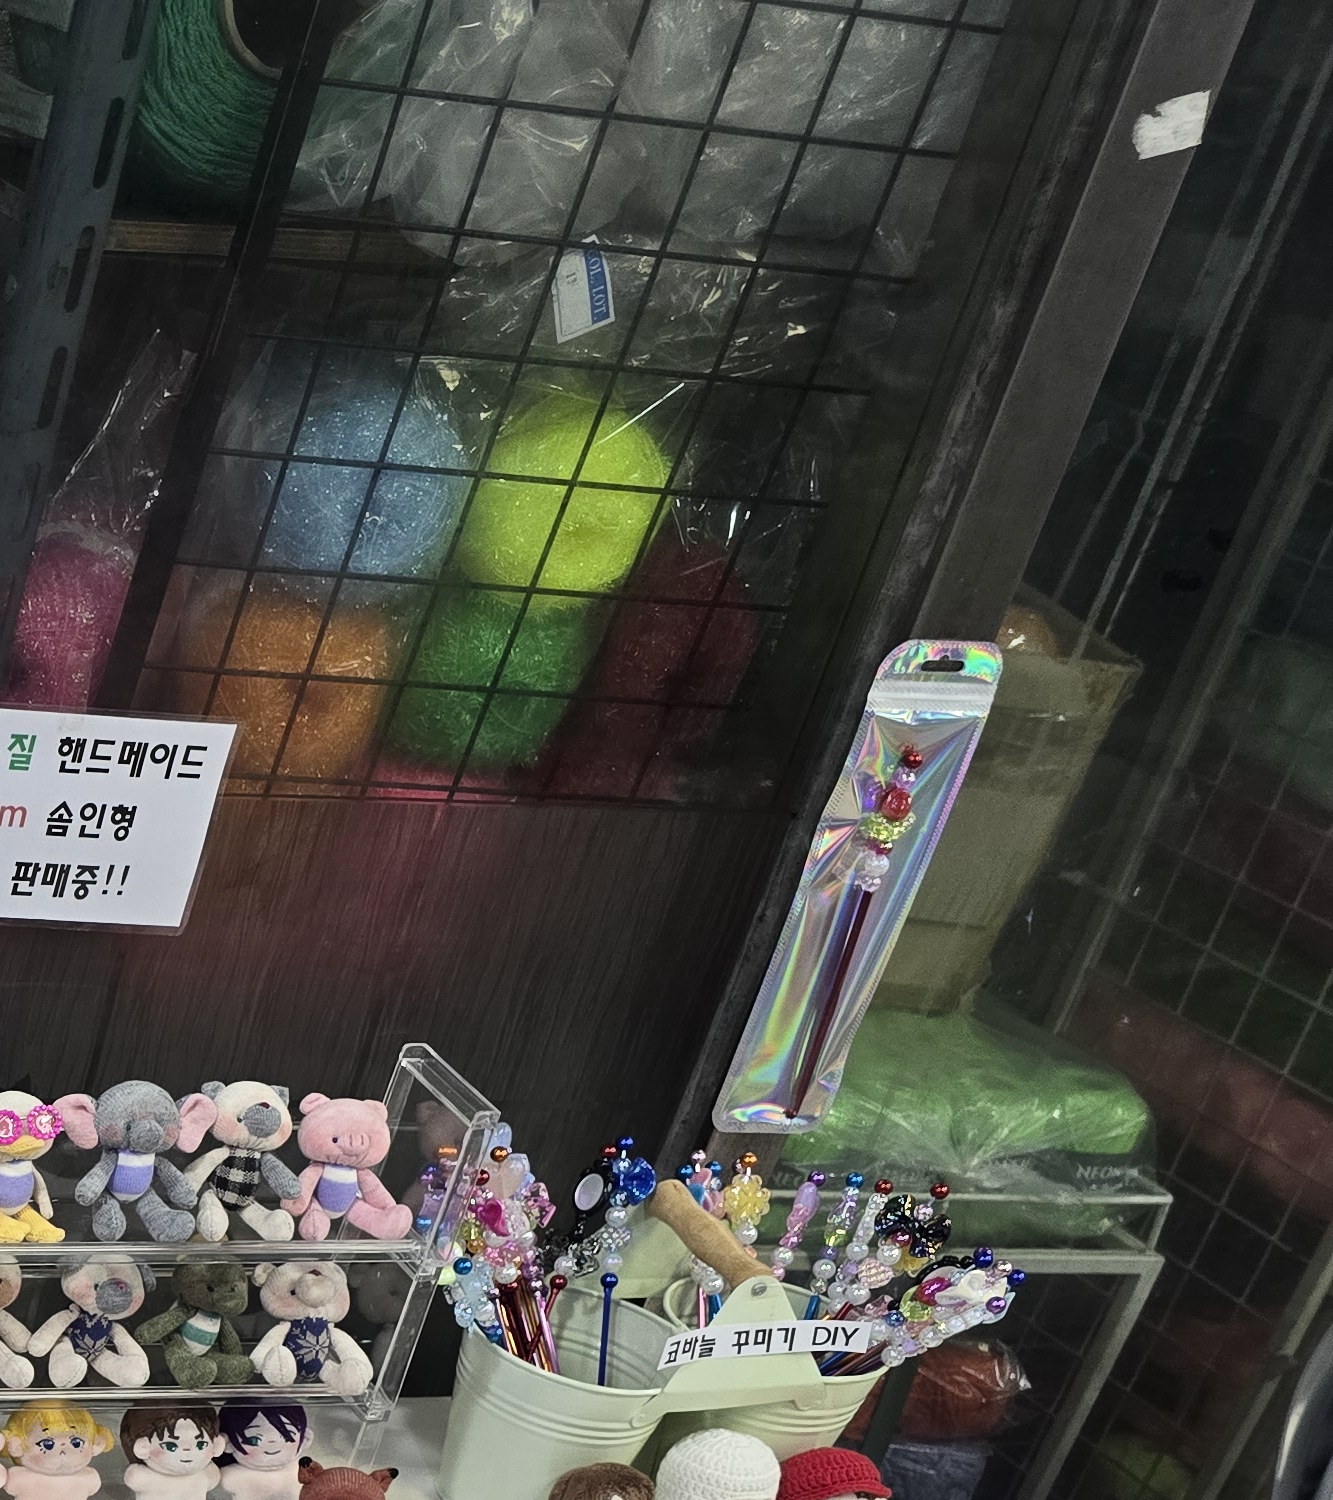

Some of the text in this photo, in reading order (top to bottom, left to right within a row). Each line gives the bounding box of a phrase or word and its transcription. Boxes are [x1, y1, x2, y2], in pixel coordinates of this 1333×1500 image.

[57, 736, 208, 780] 핸드메이드
[45, 800, 137, 842] 솜인형
[11, 860, 131, 901] 판매중!!
[731, 1327, 797, 1355] 꾸미기
[811, 1326, 860, 1347] DIY
